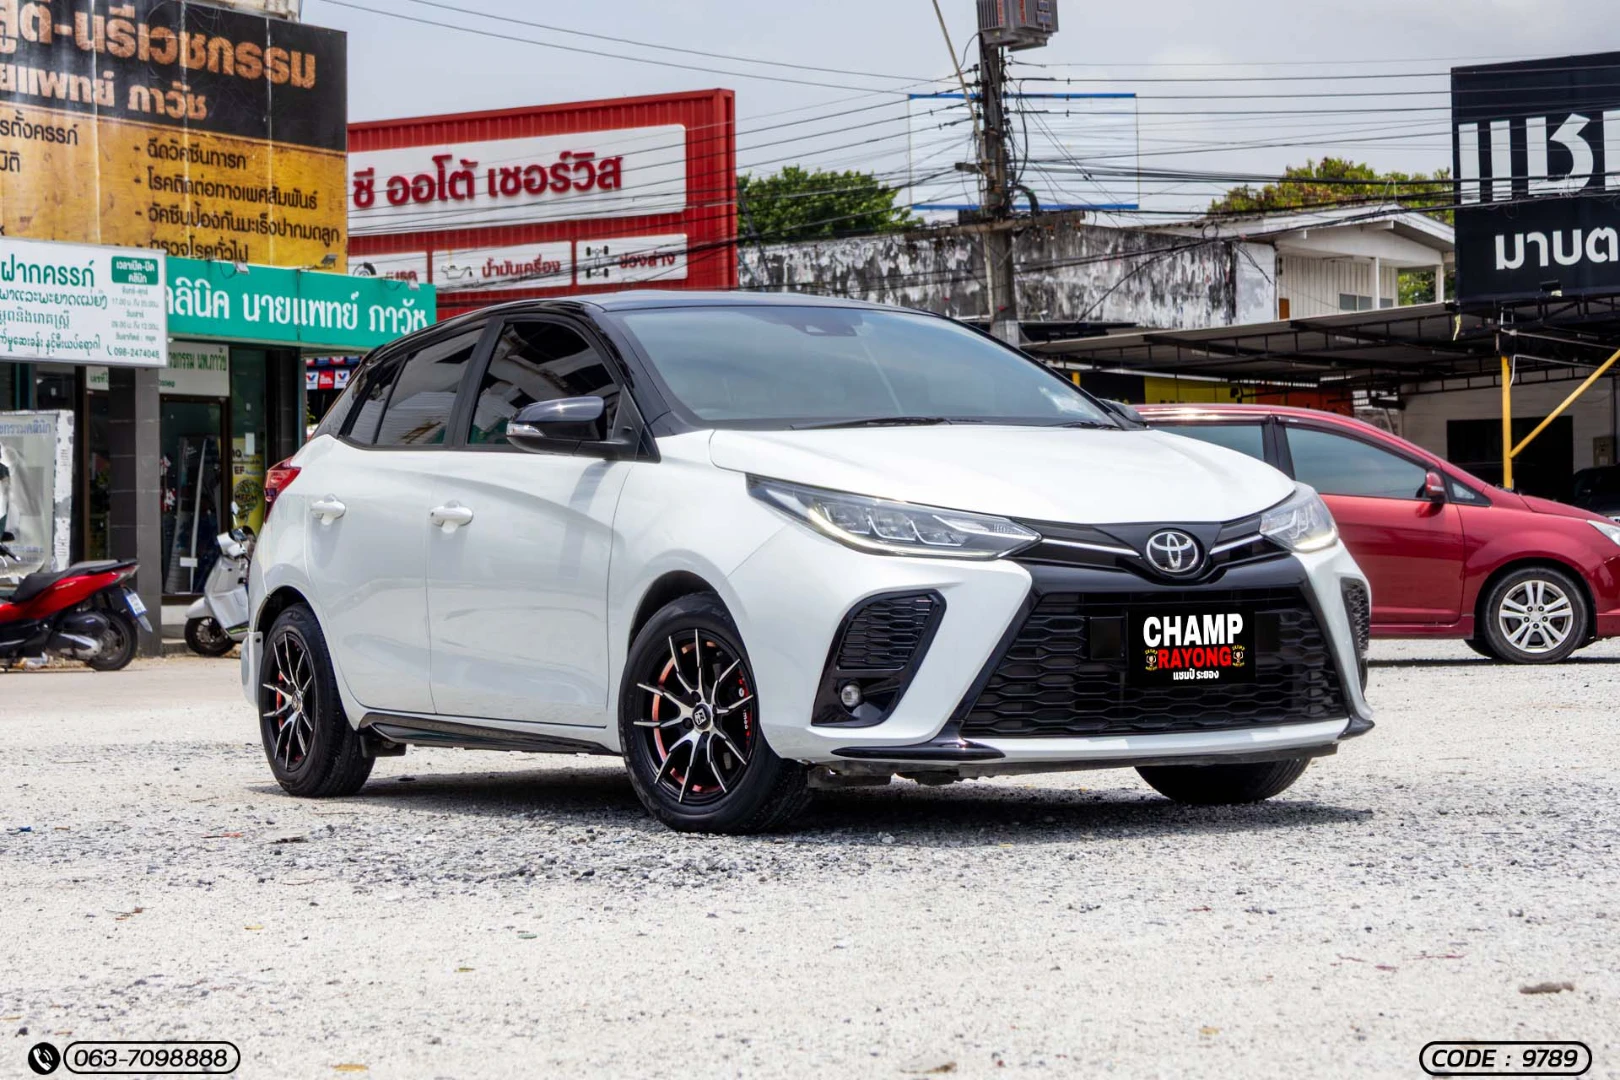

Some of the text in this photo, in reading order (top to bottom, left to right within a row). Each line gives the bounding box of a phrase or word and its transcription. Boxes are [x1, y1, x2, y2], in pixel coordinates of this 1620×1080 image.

[0, 0, 316, 89] สูต-นรีเวชกรรม
[128, 81, 207, 120] ภาวัช
[147, 138, 246, 170] ฉีดวัคซีนทารก
[1458, 109, 1620, 204] แช
[147, 166, 317, 210] โรคติดต่อทางเพศสัมพันธ์
[386, 155, 478, 206] ออโต้
[148, 199, 340, 247] วัคซีนป้องกันมะเร็งปากมดลูก
[1, 253, 95, 287] ฝากครรภ์
[482, 253, 561, 278] น้ำมันเครื่อง
[1495, 226, 1619, 270] มาบต
[243, 291, 359, 330] นายแพทย์
